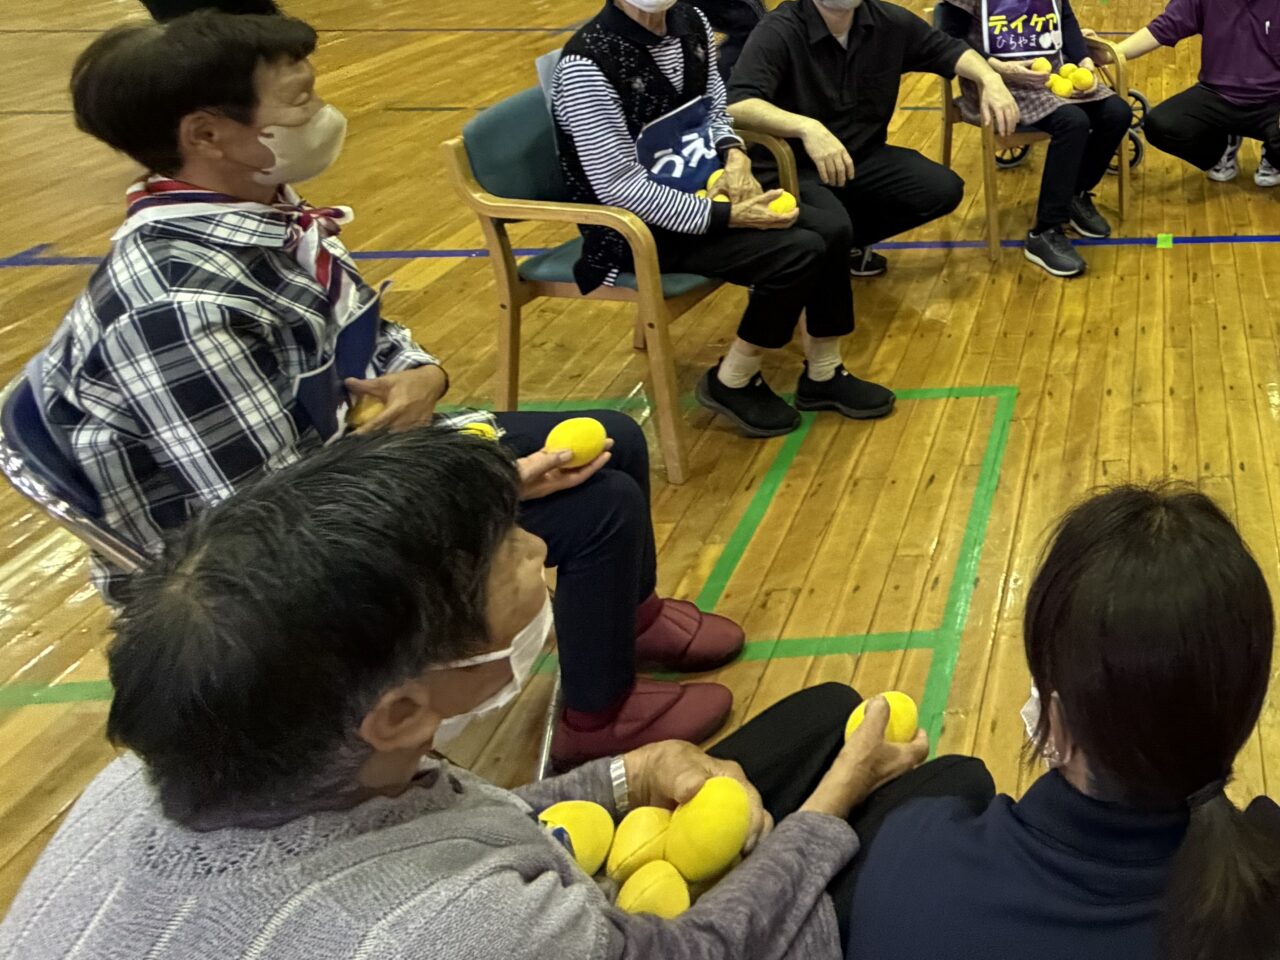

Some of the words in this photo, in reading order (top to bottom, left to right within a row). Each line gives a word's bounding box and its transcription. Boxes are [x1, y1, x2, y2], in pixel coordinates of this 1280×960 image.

[988, 13, 1057, 35] デイケア
[996, 34, 1037, 50] ひらやま
